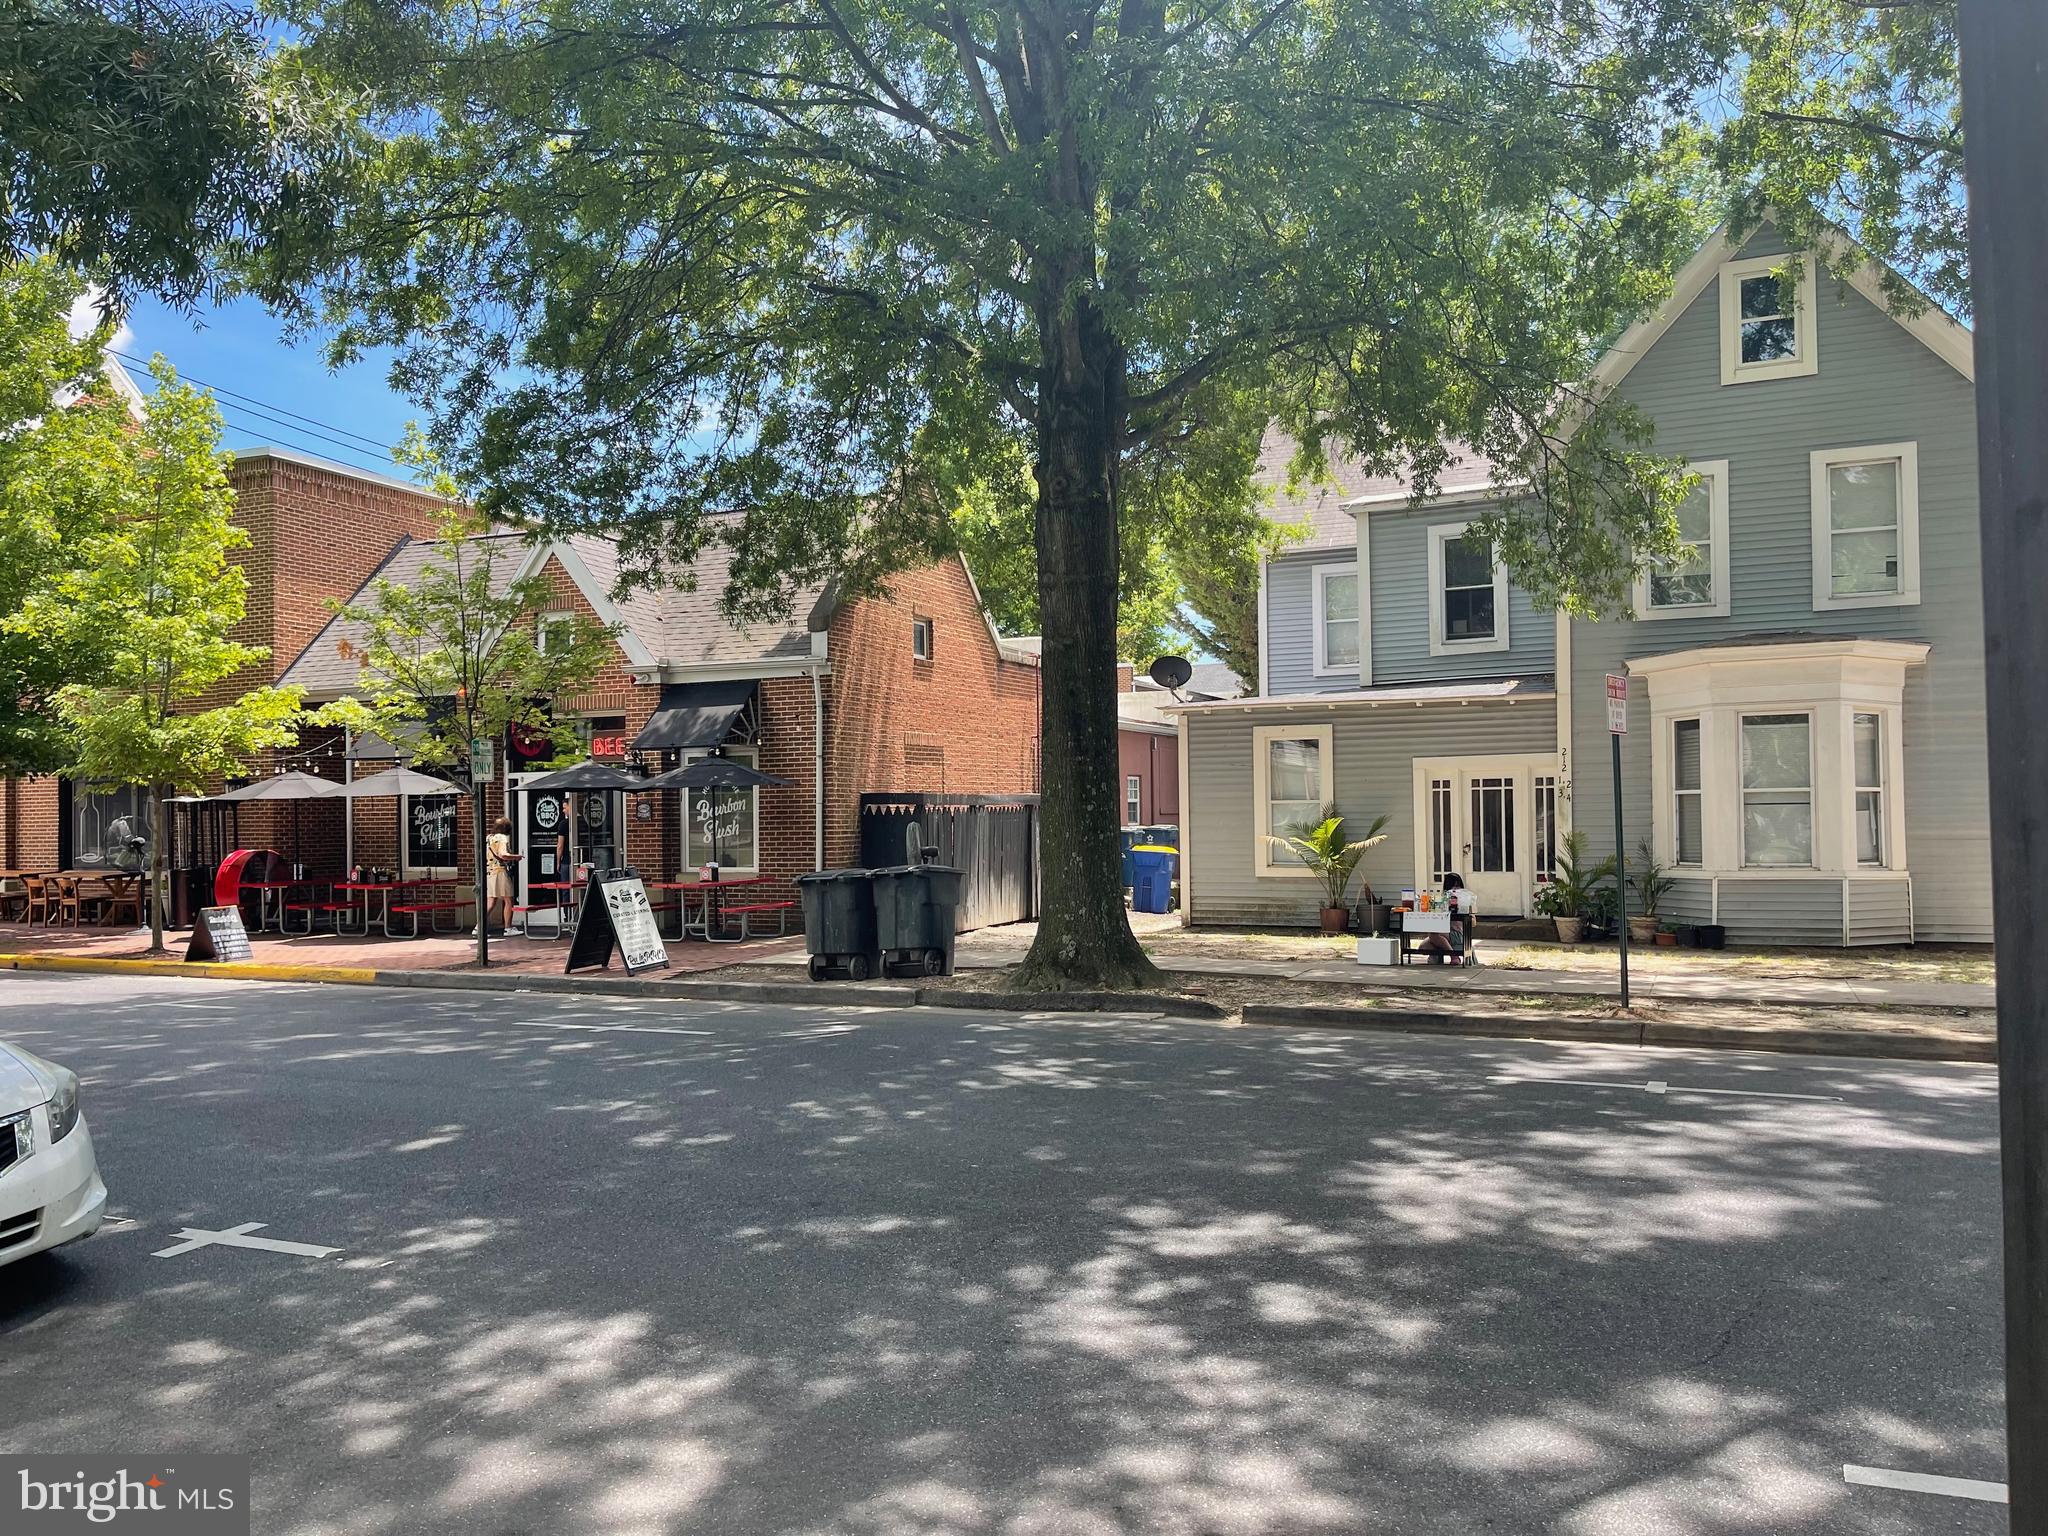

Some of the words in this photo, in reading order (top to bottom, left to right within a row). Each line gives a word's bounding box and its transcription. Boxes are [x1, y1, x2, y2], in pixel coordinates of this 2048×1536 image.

[593, 737, 625, 756] BEE
[474, 761, 492, 775] ONLY
[414, 803, 456, 826] Bourbon
[540, 811, 556, 820] BBQ
[420, 823, 450, 846] Slush
[703, 819, 740, 844] Slush
